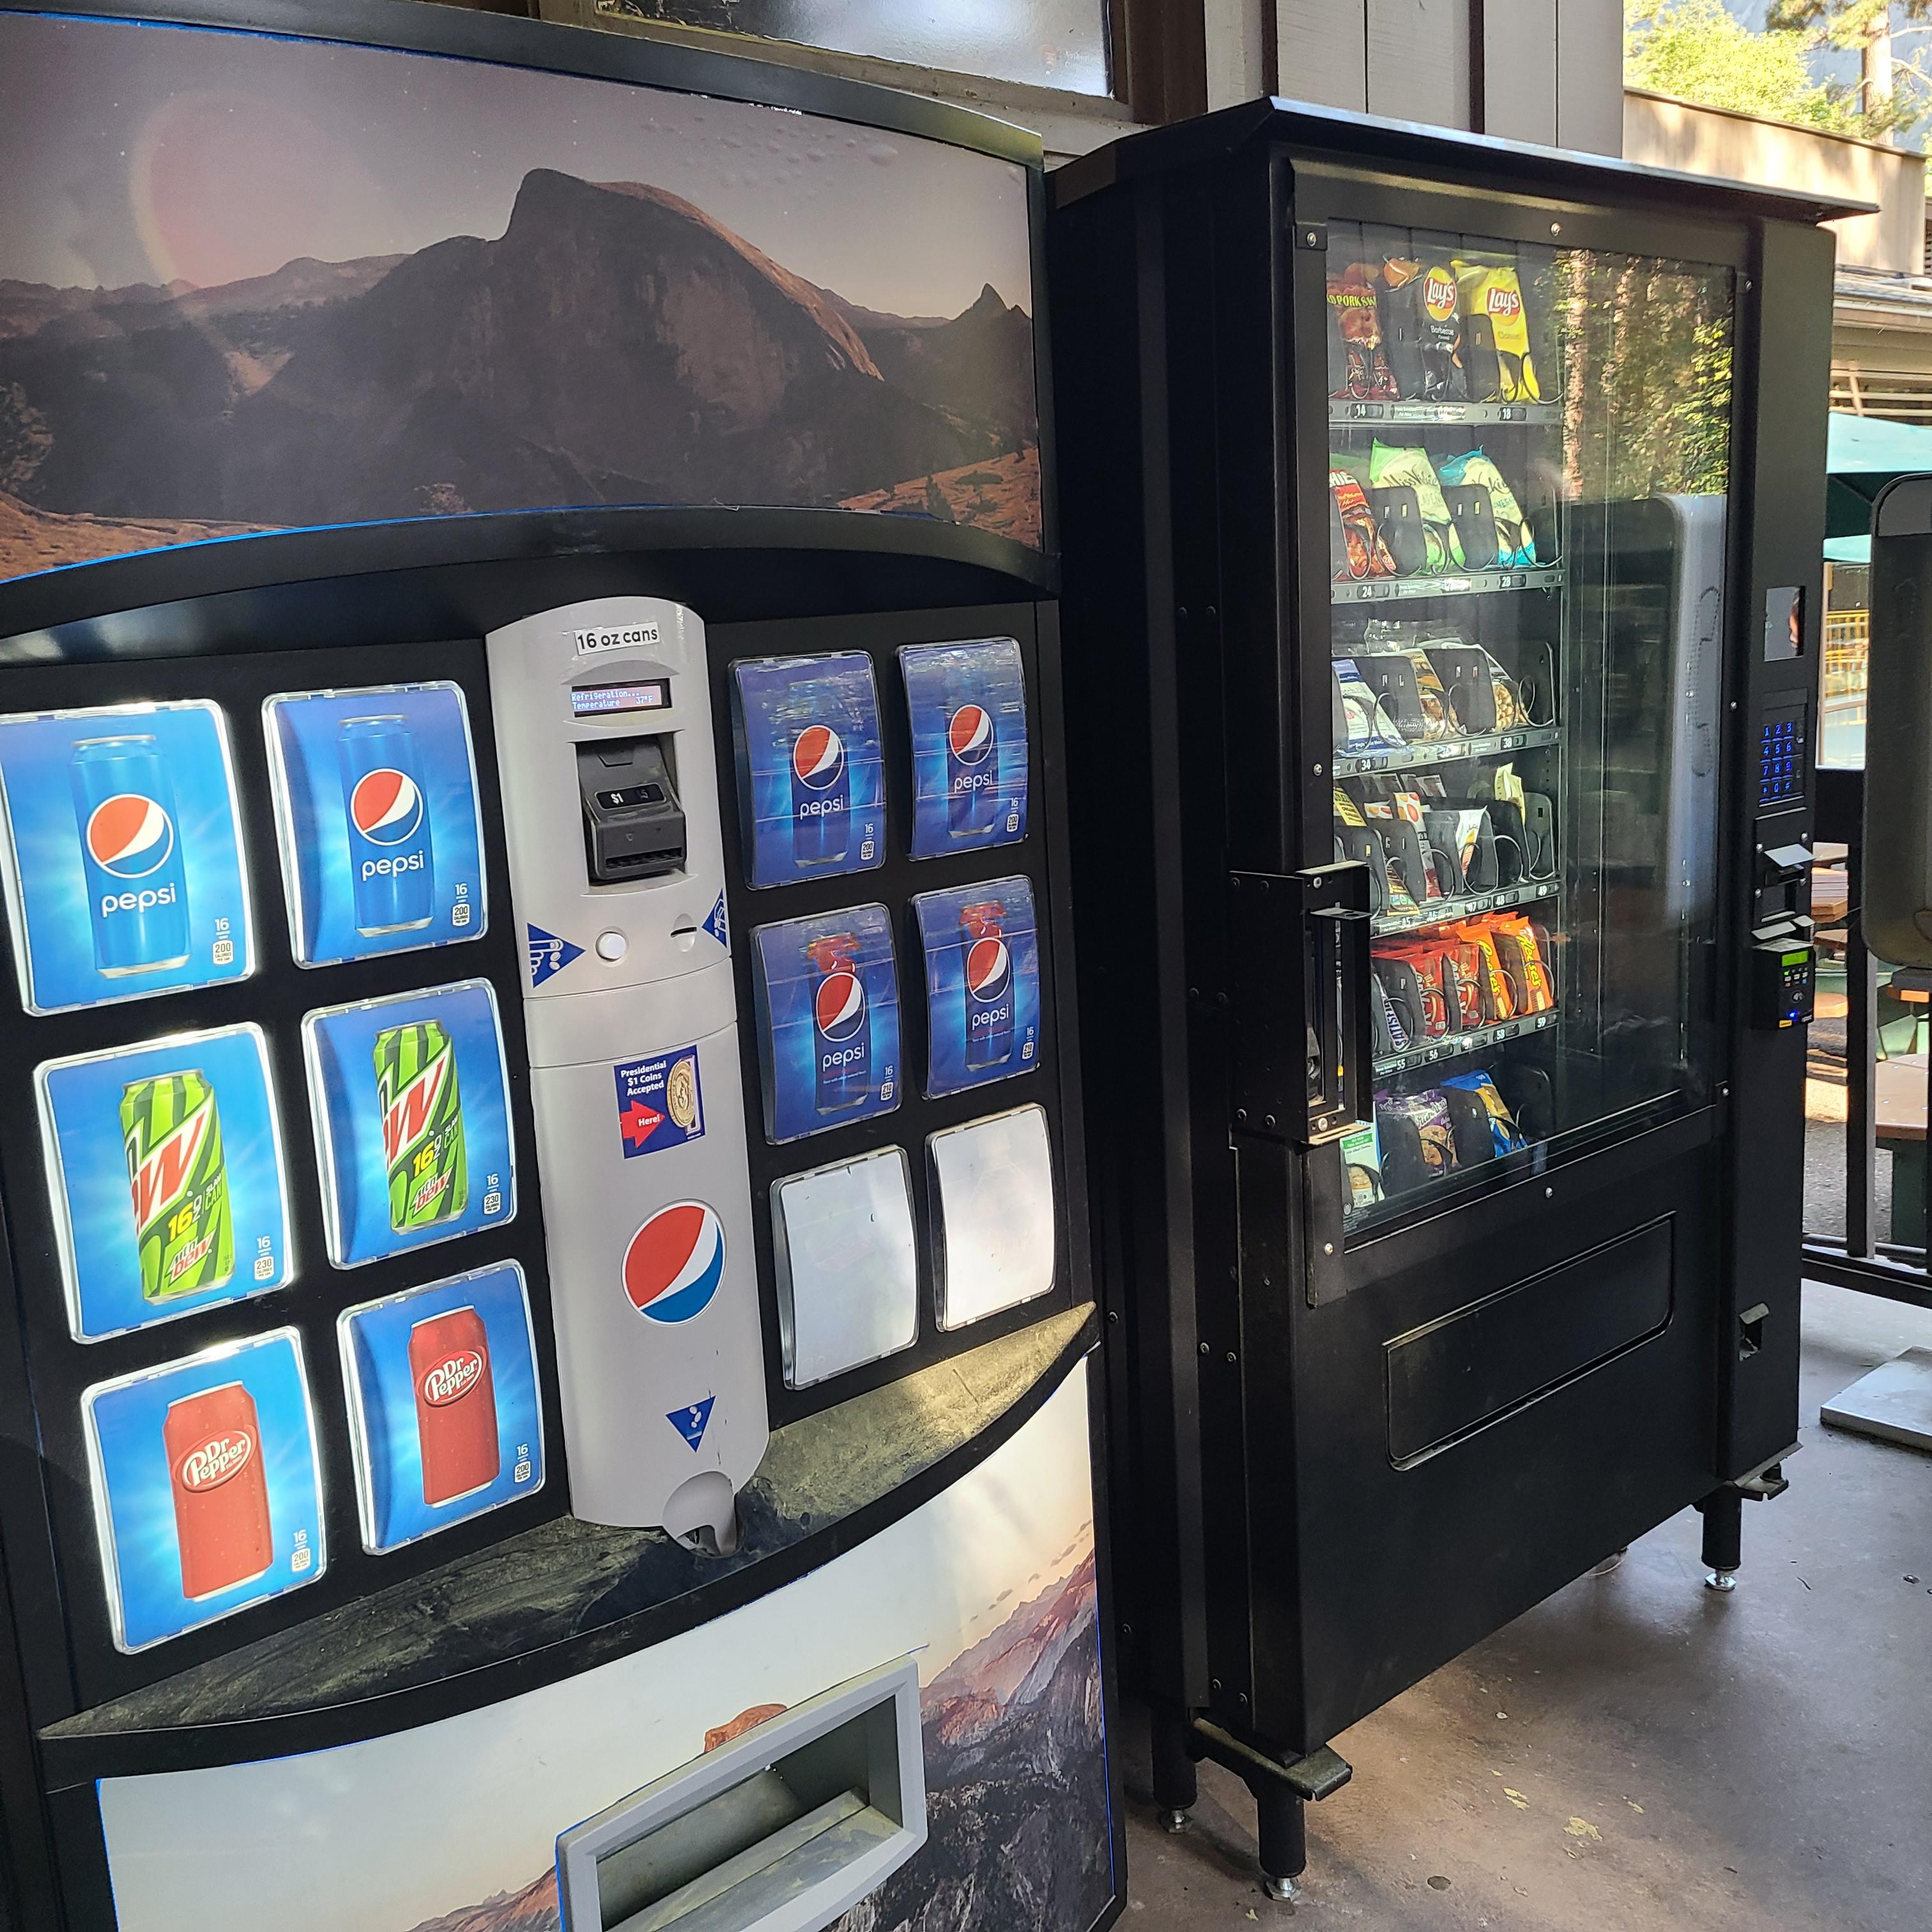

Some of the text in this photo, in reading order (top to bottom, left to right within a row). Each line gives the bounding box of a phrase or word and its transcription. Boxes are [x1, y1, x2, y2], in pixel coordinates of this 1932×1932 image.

[1427, 278, 1454, 309] Lay's
[1336, 295, 1361, 307] PORK
[1488, 288, 1519, 316] Lay's
[1502, 408, 1511, 420] 18
[1501, 576, 1511, 587] 28
[1361, 586, 1372, 598] 24
[578, 629, 657, 650] 16 oz cans
[572, 700, 620, 710] Temperature
[1765, 723, 1791, 737] 1 2 3
[1763, 746, 1769, 756] 4
[1775, 744, 1780, 754] 5
[1361, 759, 1372, 770] 34
[1763, 765, 1768, 776] 7
[954, 769, 992, 793] pepsi
[800, 793, 843, 820] pepsi
[864, 823, 873, 834] 16
[362, 850, 424, 882] pepsi
[454, 883, 468, 895] 16
[102, 882, 176, 918] pepsi
[1496, 894, 1505, 905] 48
[454, 905, 468, 916] 200
[215, 917, 230, 931] 16
[215, 942, 231, 953] 200
[1515, 935, 1542, 988] Reese's
[972, 1003, 1009, 1031] pepsi
[1537, 1016, 1546, 1028] 59
[1496, 1029, 1505, 1040] 58
[822, 1042, 864, 1072] pepsi
[1429, 1050, 1438, 1061] 56
[620, 1060, 666, 1078] Presidential
[885, 1065, 893, 1076] 16
[1397, 1058, 1406, 1071] 55
[627, 1072, 662, 1087] $1 Coins
[627, 1080, 664, 1096] Accepted
[882, 1084, 892, 1092] 210
[638, 1114, 660, 1127] Here!
[413, 1140, 436, 1177] 16
[487, 1173, 499, 1186] 16
[486, 1194, 499, 1205] 230
[168, 1202, 194, 1241] 16
[257, 1235, 271, 1249] 16
[256, 1258, 272, 1269] 230
[443, 1358, 464, 1379] Dr
[426, 1359, 477, 1401] Pepper
[204, 1438, 230, 1463] Dr
[516, 1443, 528, 1456] 16
[187, 1439, 246, 1487] Pepper
[516, 1462, 529, 1474] 200
[293, 1529, 307, 1543] 16
[294, 1550, 309, 1562] 200
